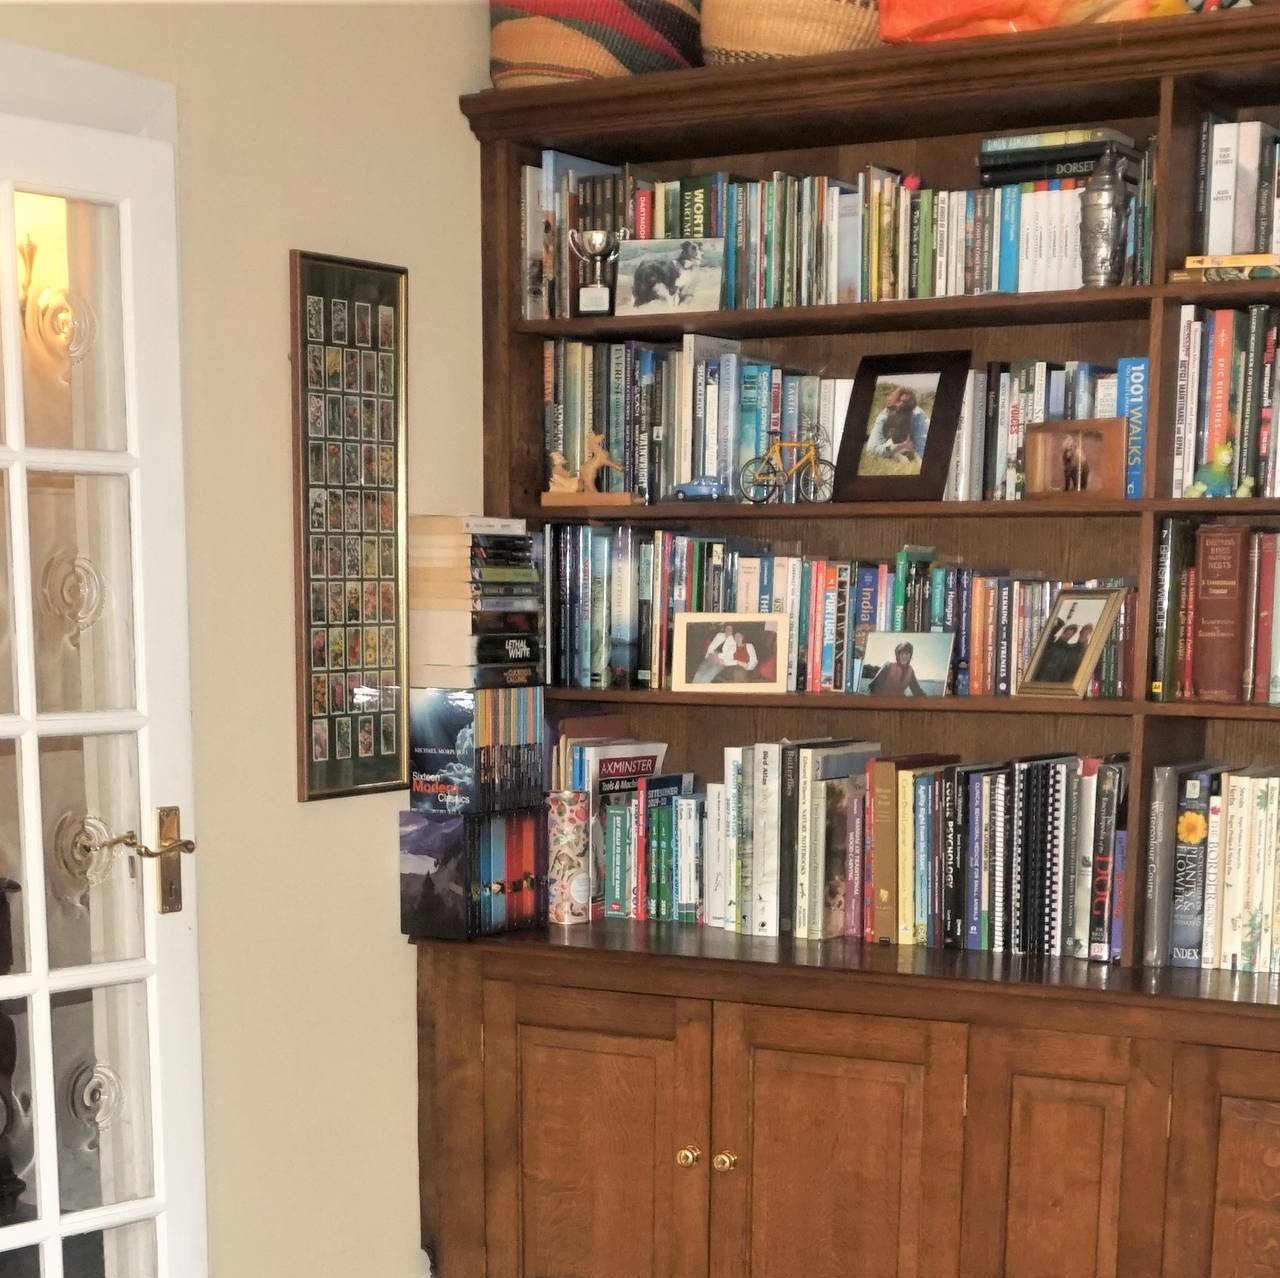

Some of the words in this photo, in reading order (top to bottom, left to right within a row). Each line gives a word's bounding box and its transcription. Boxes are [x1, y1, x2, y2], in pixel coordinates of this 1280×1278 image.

[1056, 160, 1095, 175] DORSET
[696, 365, 705, 418] SHACKLETON
[788, 382, 796, 414] EARTH
[1131, 367, 1145, 403] 1001
[1009, 403, 1020, 435] VOICES
[1214, 402, 1222, 429] RIDES
[1129, 405, 1143, 459] WALKS
[1157, 545, 1169, 585] BRITISH
[824, 592, 837, 647] PORTUGAL
[860, 587, 874, 622] India
[895, 605, 905, 631] Norm
[945, 591, 955, 626] Hungary
[1001, 587, 1010, 625] TREKKING
[1156, 587, 1167, 633] WILDLIFE
[836, 588, 848, 659] TAIWAN
[505, 639, 527, 649] LETHAL
[509, 648, 531, 659] WHITE
[999, 640, 1009, 678] PYRENEES
[412, 771, 441, 782] Sixteen
[600, 758, 653, 775] AXMINSTER
[732, 760, 740, 790] Devon
[785, 750, 795, 797] Butterflies
[412, 780, 459, 793] Modern
[918, 785, 926, 807] Agility
[946, 782, 954, 818] COLLIE
[1229, 784, 1238, 807] Herbs
[800, 808, 808, 833] NATURE
[918, 808, 926, 824] Right
[1147, 800, 1160, 861] Watercolour
[854, 846, 861, 854] OF
[945, 821, 954, 888] PSYCHOLOGY
[853, 856, 861, 895] TRADITIONAL
[1146, 868, 1158, 900] Course
[1174, 845, 1189, 913] FLOWERS
[1185, 846, 1199, 899] PLANTS
[1184, 901, 1196, 914] &
[1173, 949, 1200, 962] INDEX
